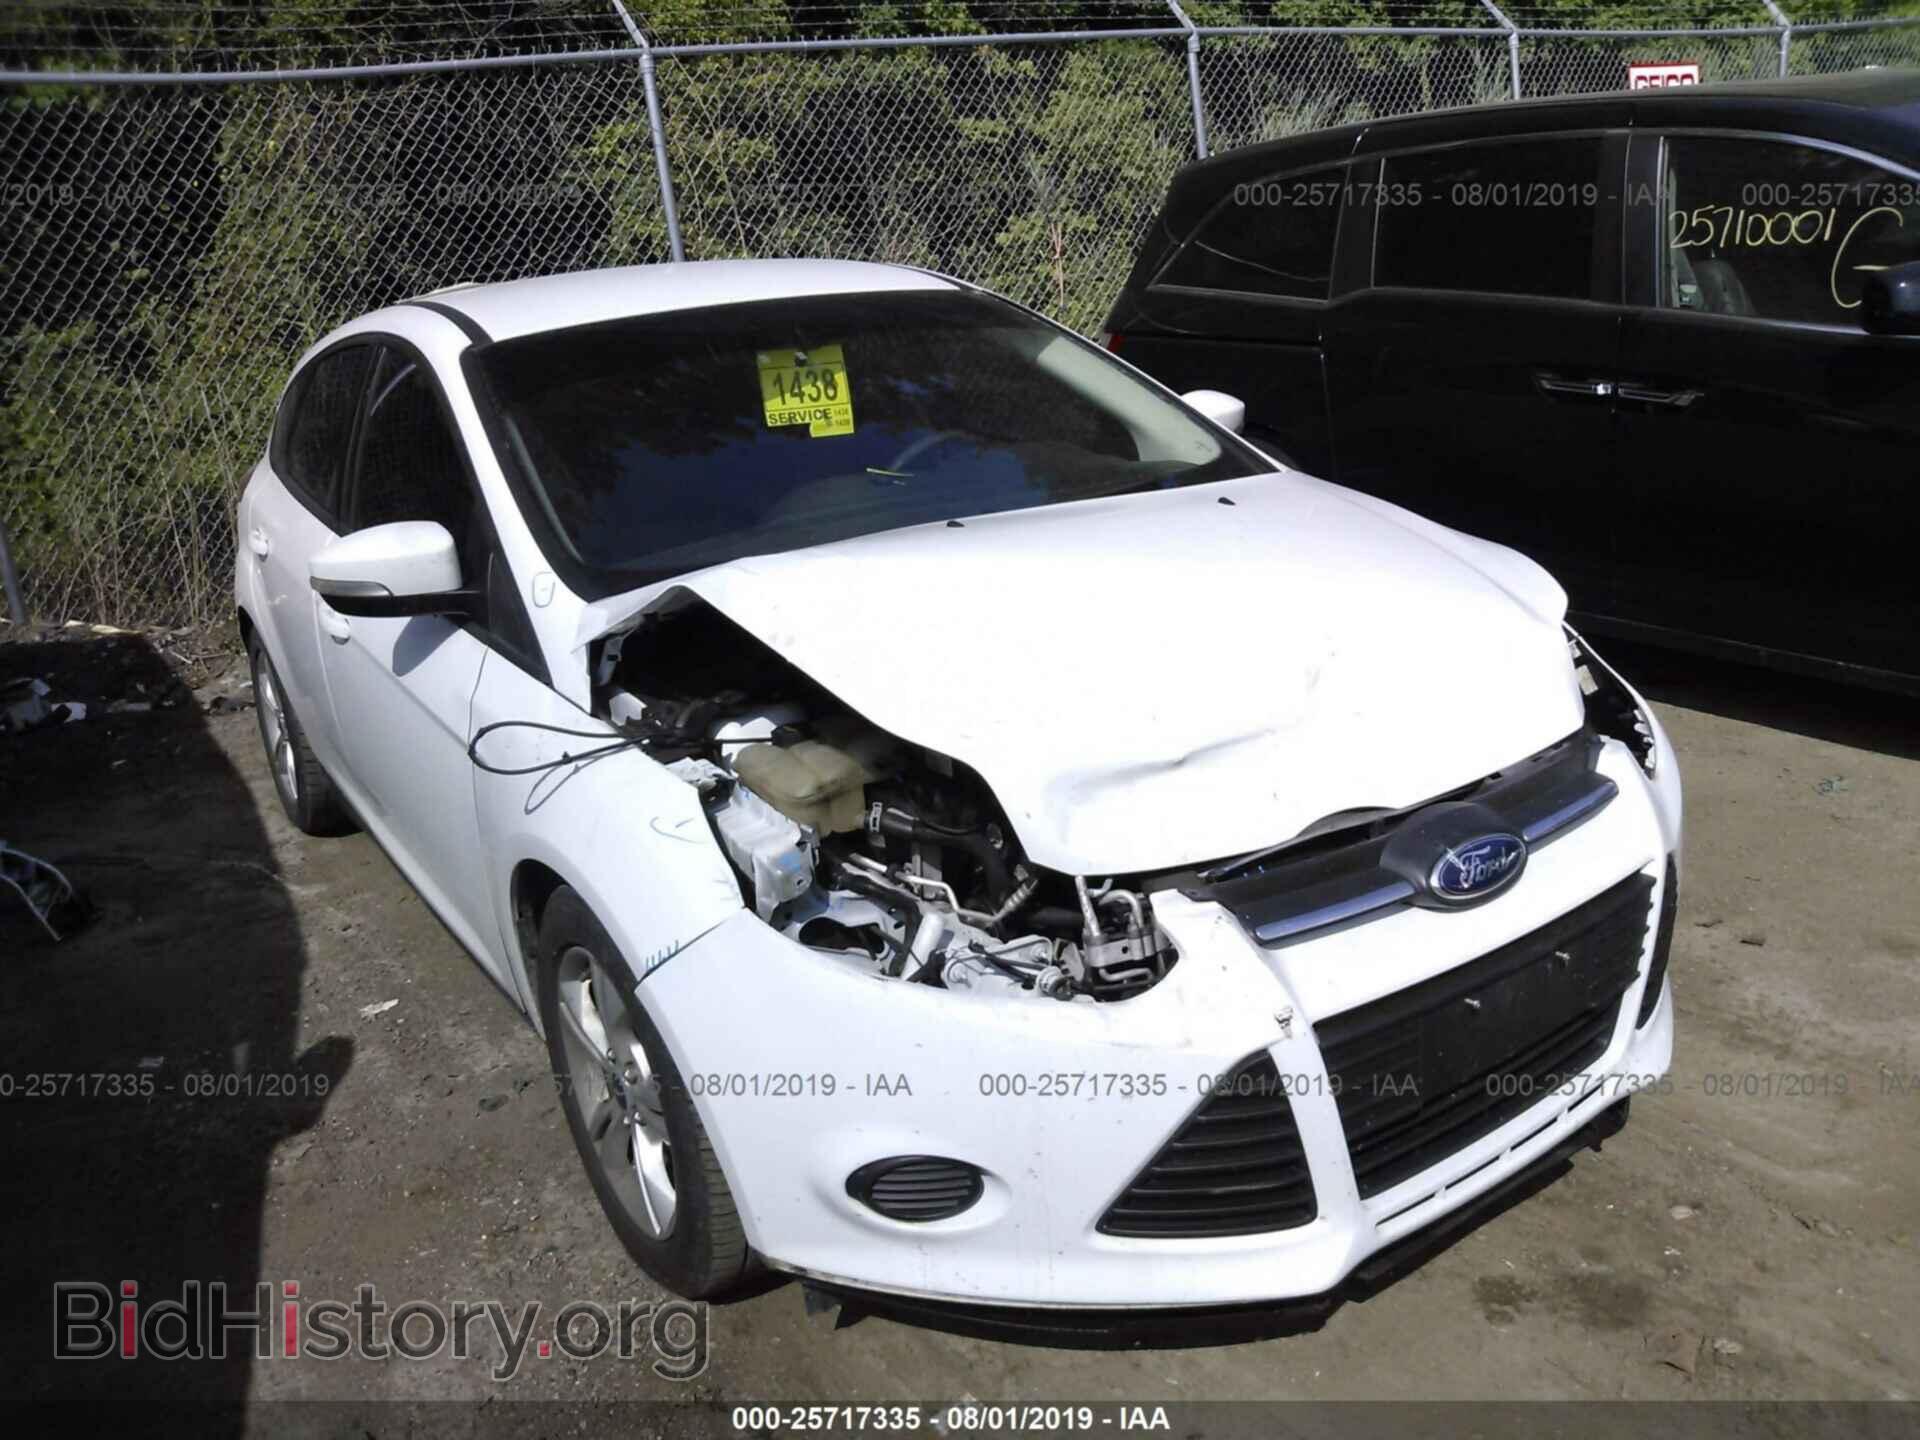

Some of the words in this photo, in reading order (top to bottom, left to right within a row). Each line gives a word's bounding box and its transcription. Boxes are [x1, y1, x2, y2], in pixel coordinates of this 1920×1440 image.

[1669, 204, 1836, 249] 25710001
[773, 369, 838, 405] 1438
[769, 408, 832, 425] SERVICE
[1456, 845, 1518, 889] Ford
